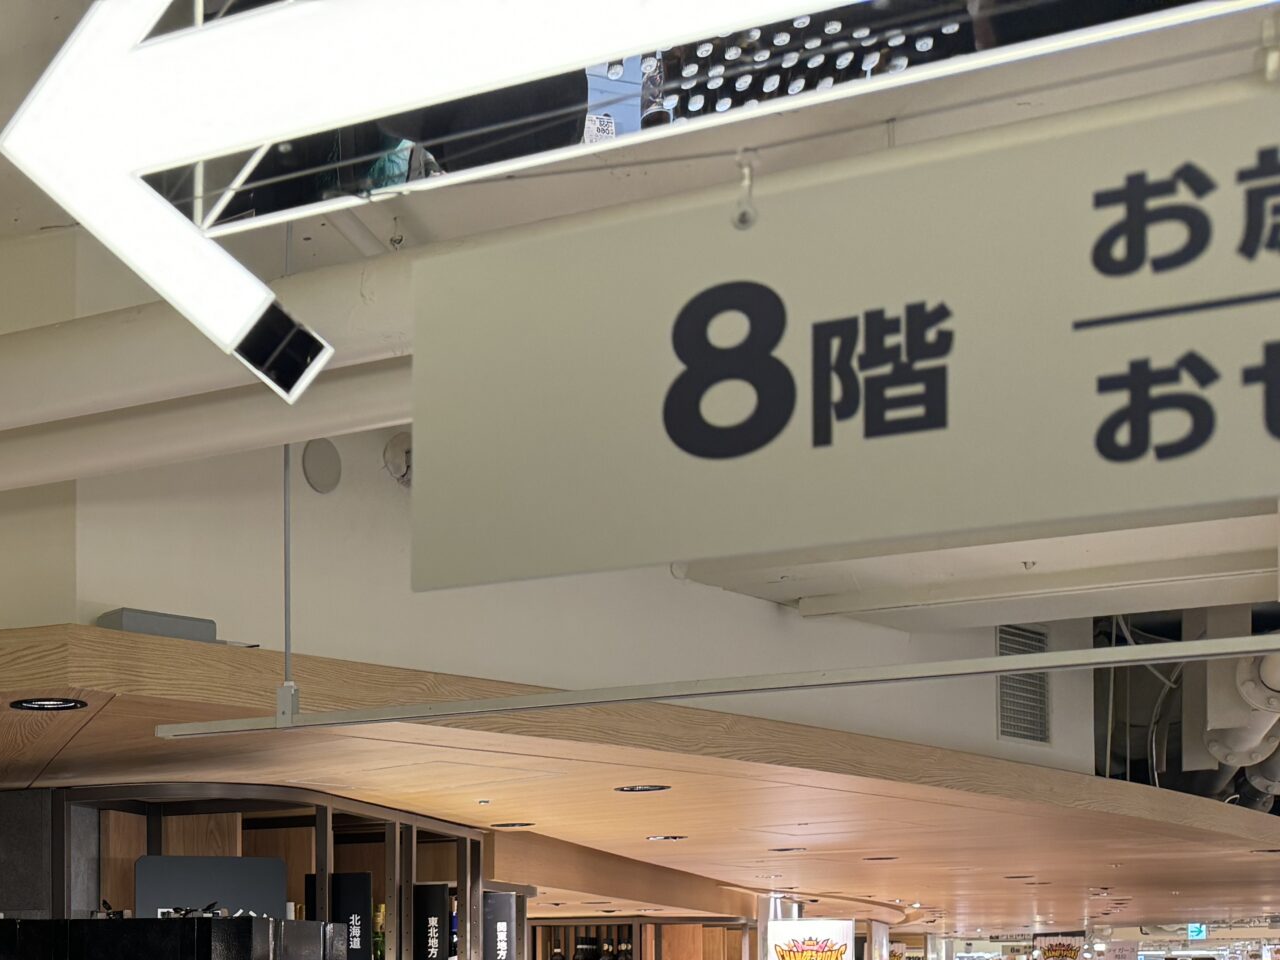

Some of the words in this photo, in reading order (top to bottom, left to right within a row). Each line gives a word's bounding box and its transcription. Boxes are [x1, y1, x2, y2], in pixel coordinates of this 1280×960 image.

[662, 280, 955, 460] 8階
[349, 914, 361, 949] 北海道
[427, 917, 439, 958] 東北地方
[496, 921, 508, 960] 関東地方
